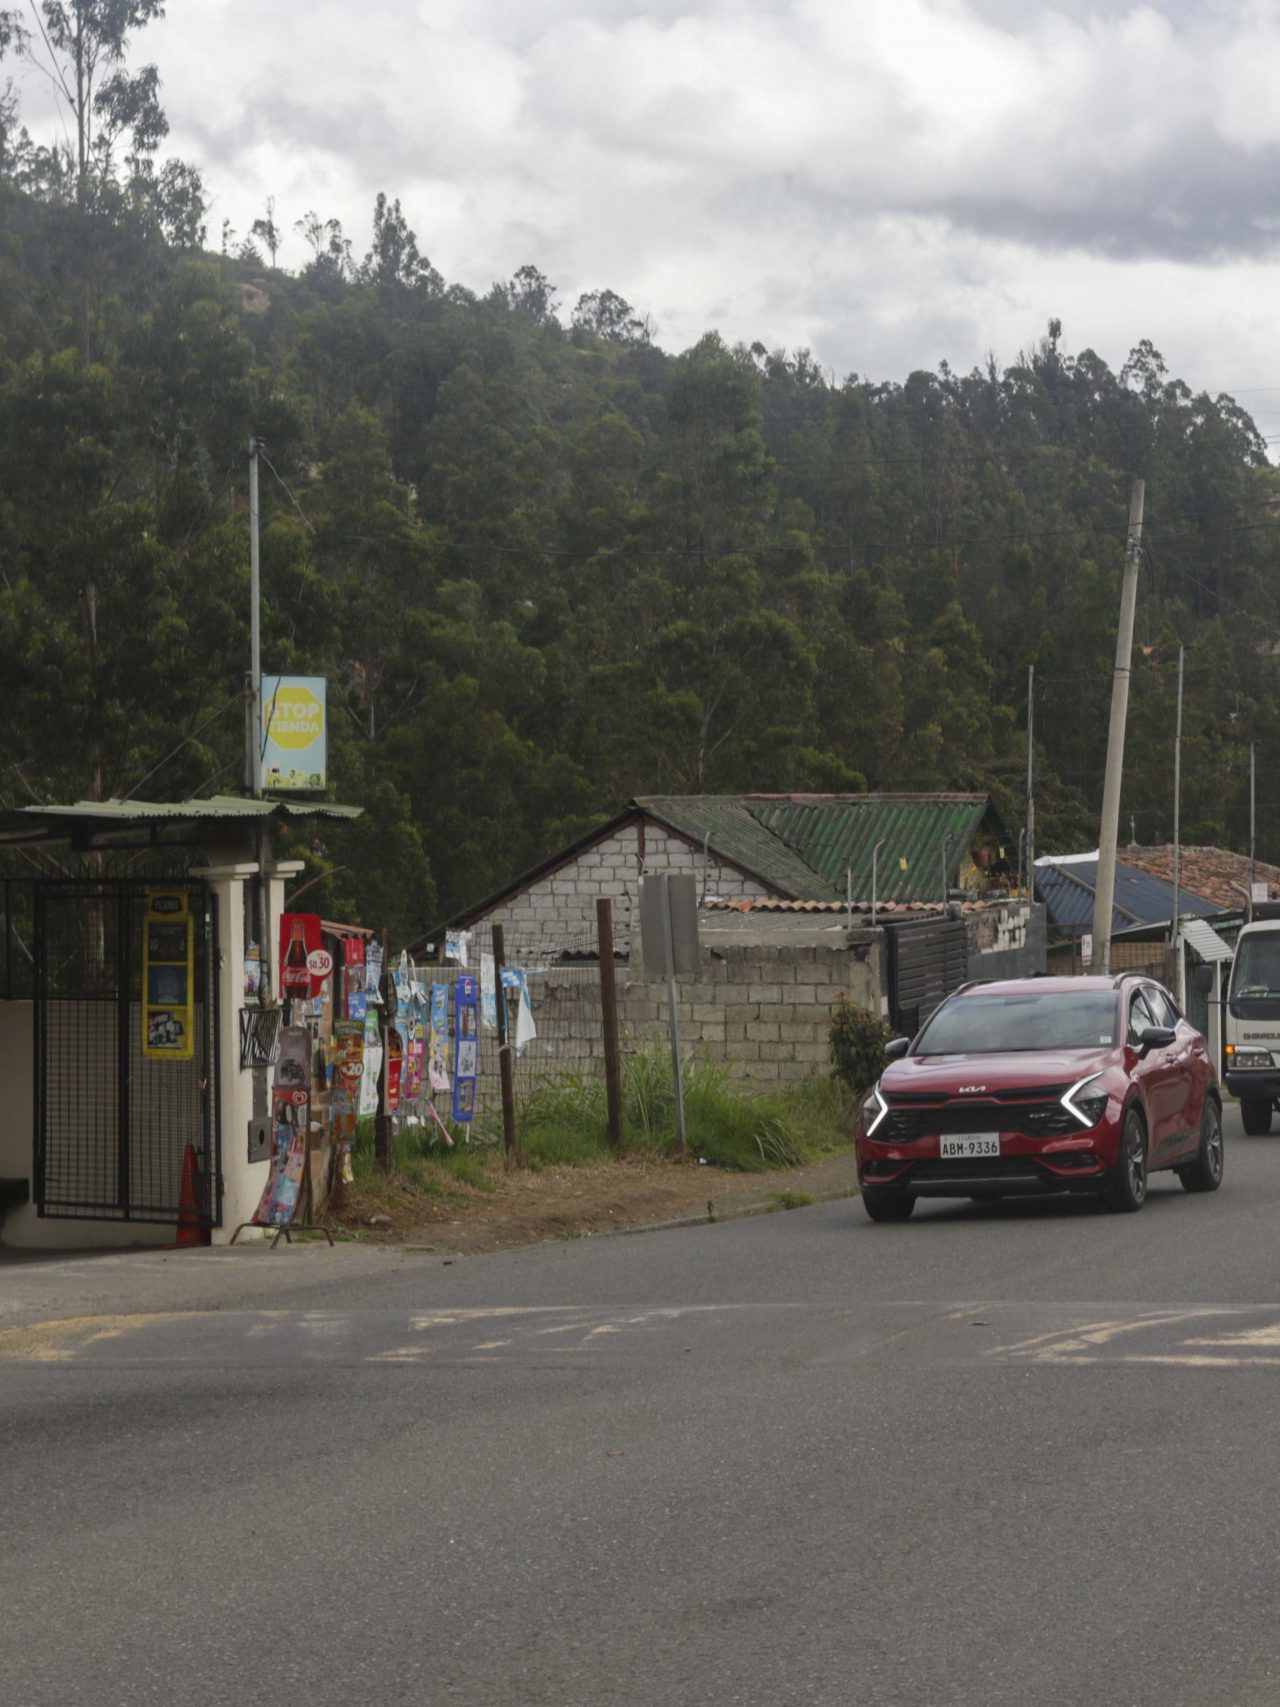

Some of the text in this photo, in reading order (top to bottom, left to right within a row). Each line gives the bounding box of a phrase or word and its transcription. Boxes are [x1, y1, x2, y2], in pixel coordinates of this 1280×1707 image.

[268, 702, 319, 719] STOP
[268, 721, 319, 733] TIENDA
[959, 1085, 986, 1093] KIA
[942, 1141, 998, 1156] ABM-9336
